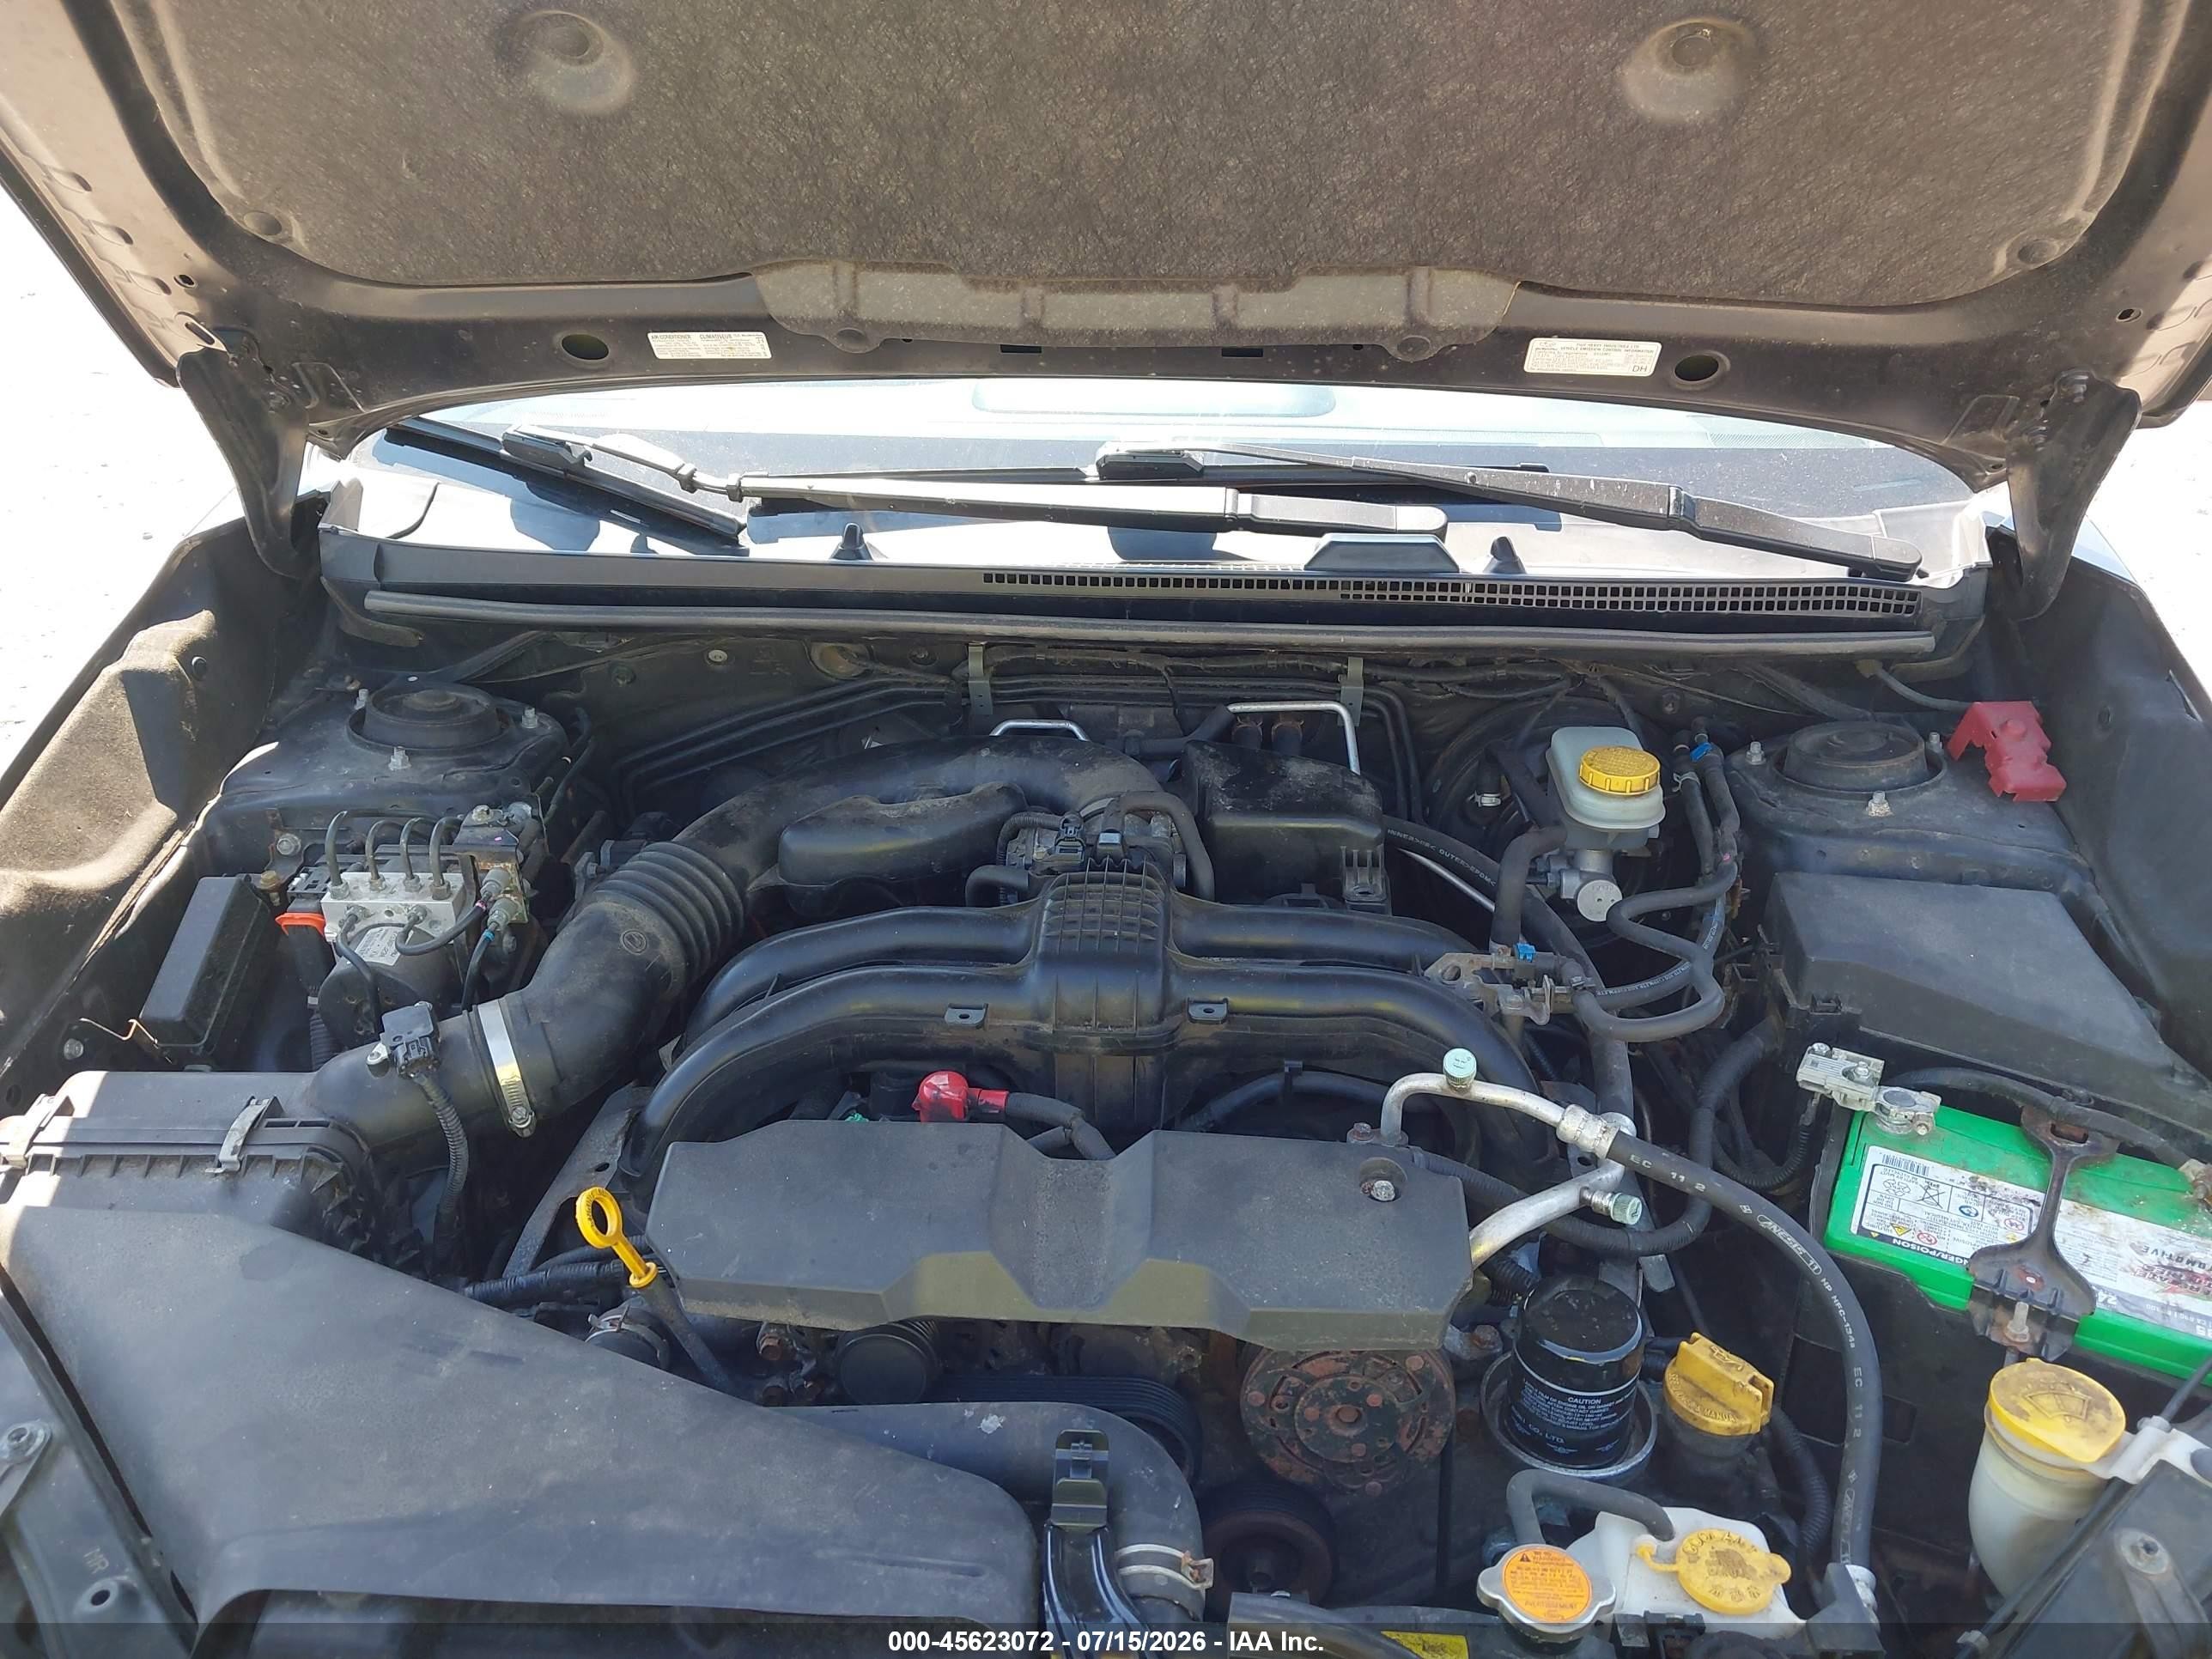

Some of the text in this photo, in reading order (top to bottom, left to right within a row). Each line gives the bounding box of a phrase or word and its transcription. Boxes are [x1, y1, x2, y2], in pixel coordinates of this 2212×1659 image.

[1630, 1154, 1652, 1169] EC
[1892, 1237, 1969, 1267] NGER/POISON
[1567, 1396, 1601, 1405] CAUTION
